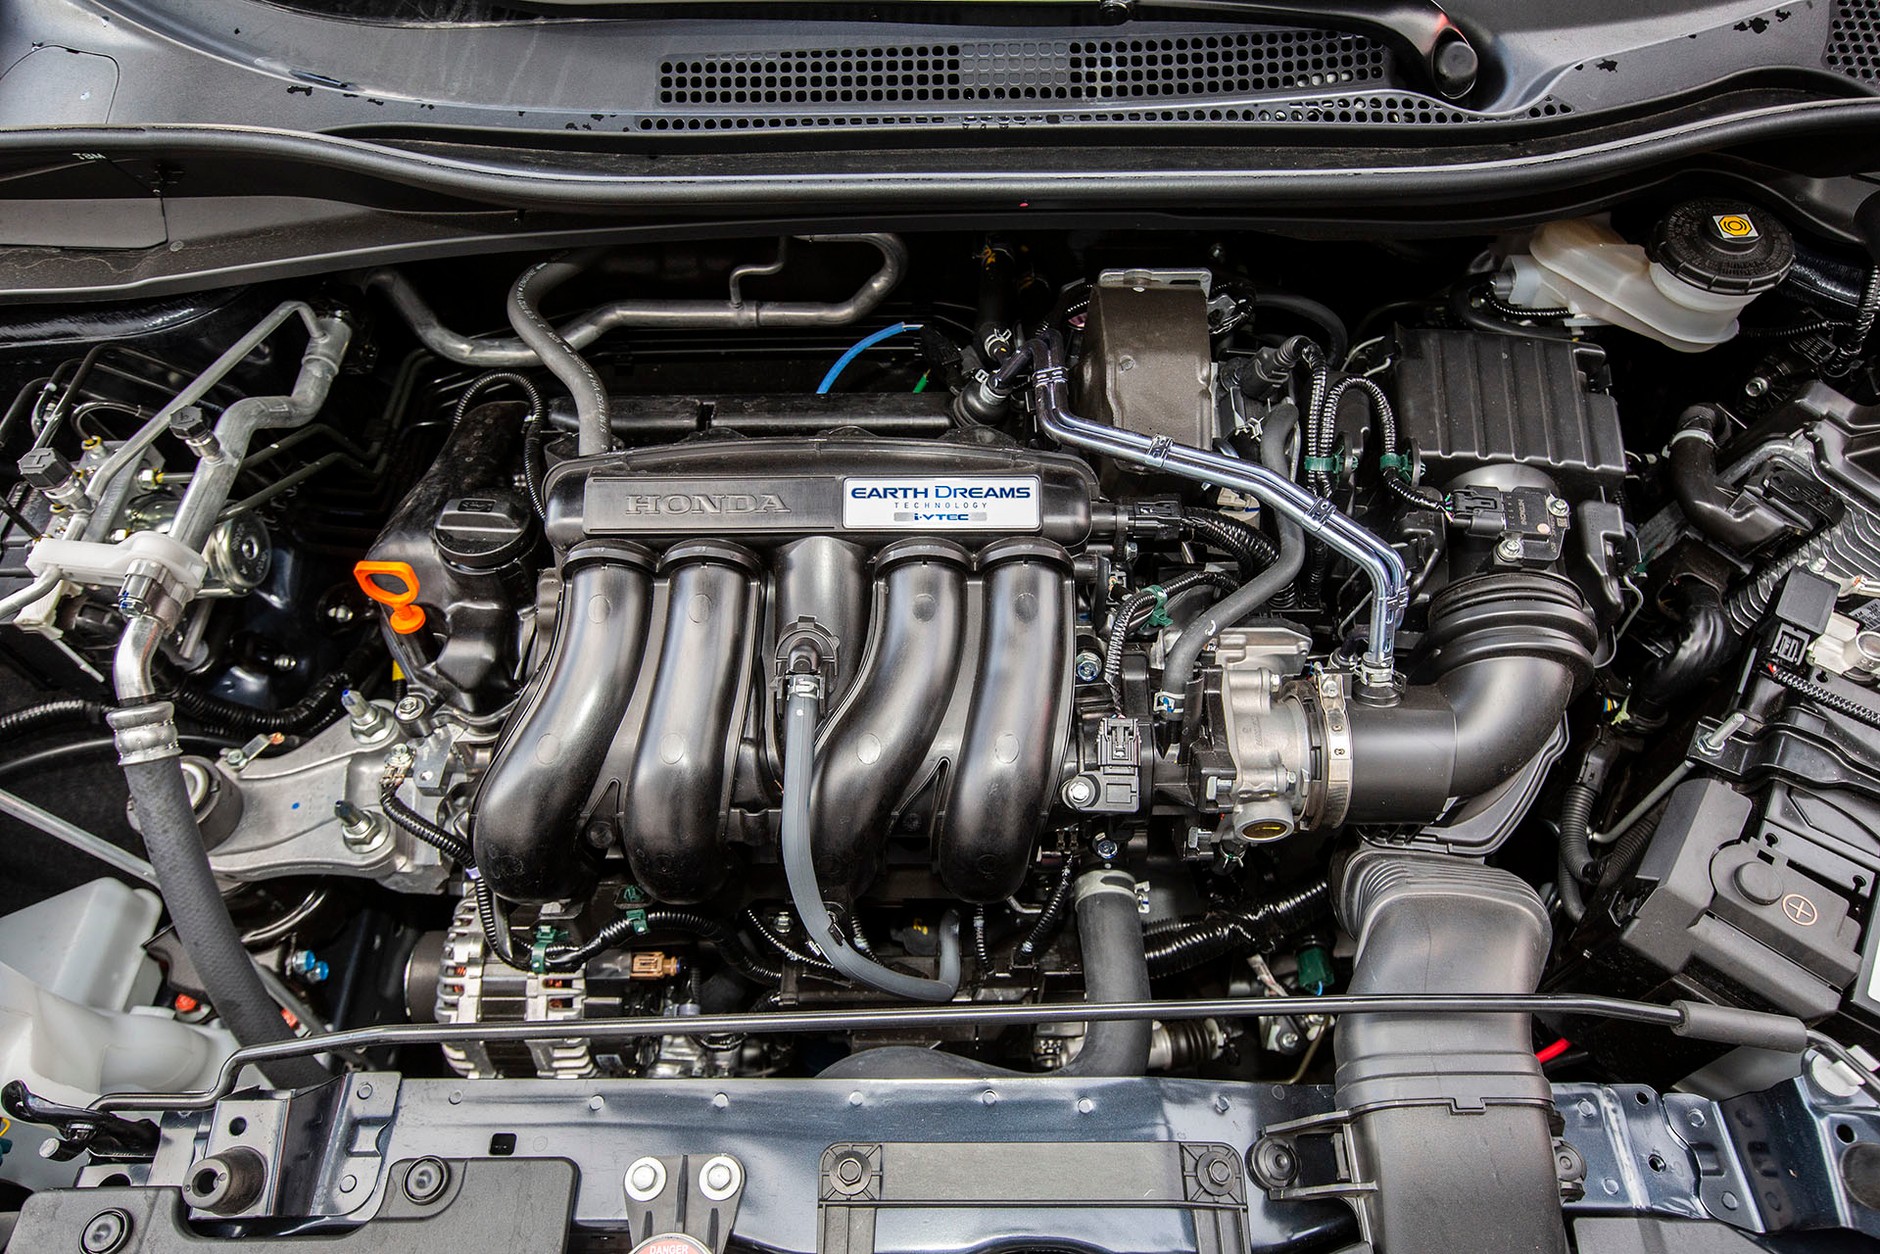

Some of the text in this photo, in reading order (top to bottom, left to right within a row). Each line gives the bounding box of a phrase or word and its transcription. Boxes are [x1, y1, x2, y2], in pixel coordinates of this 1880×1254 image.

[851, 485, 1031, 499] EARTH DREAMS
[625, 494, 791, 515] HONDA
[650, 1245, 688, 1254] DANGER
